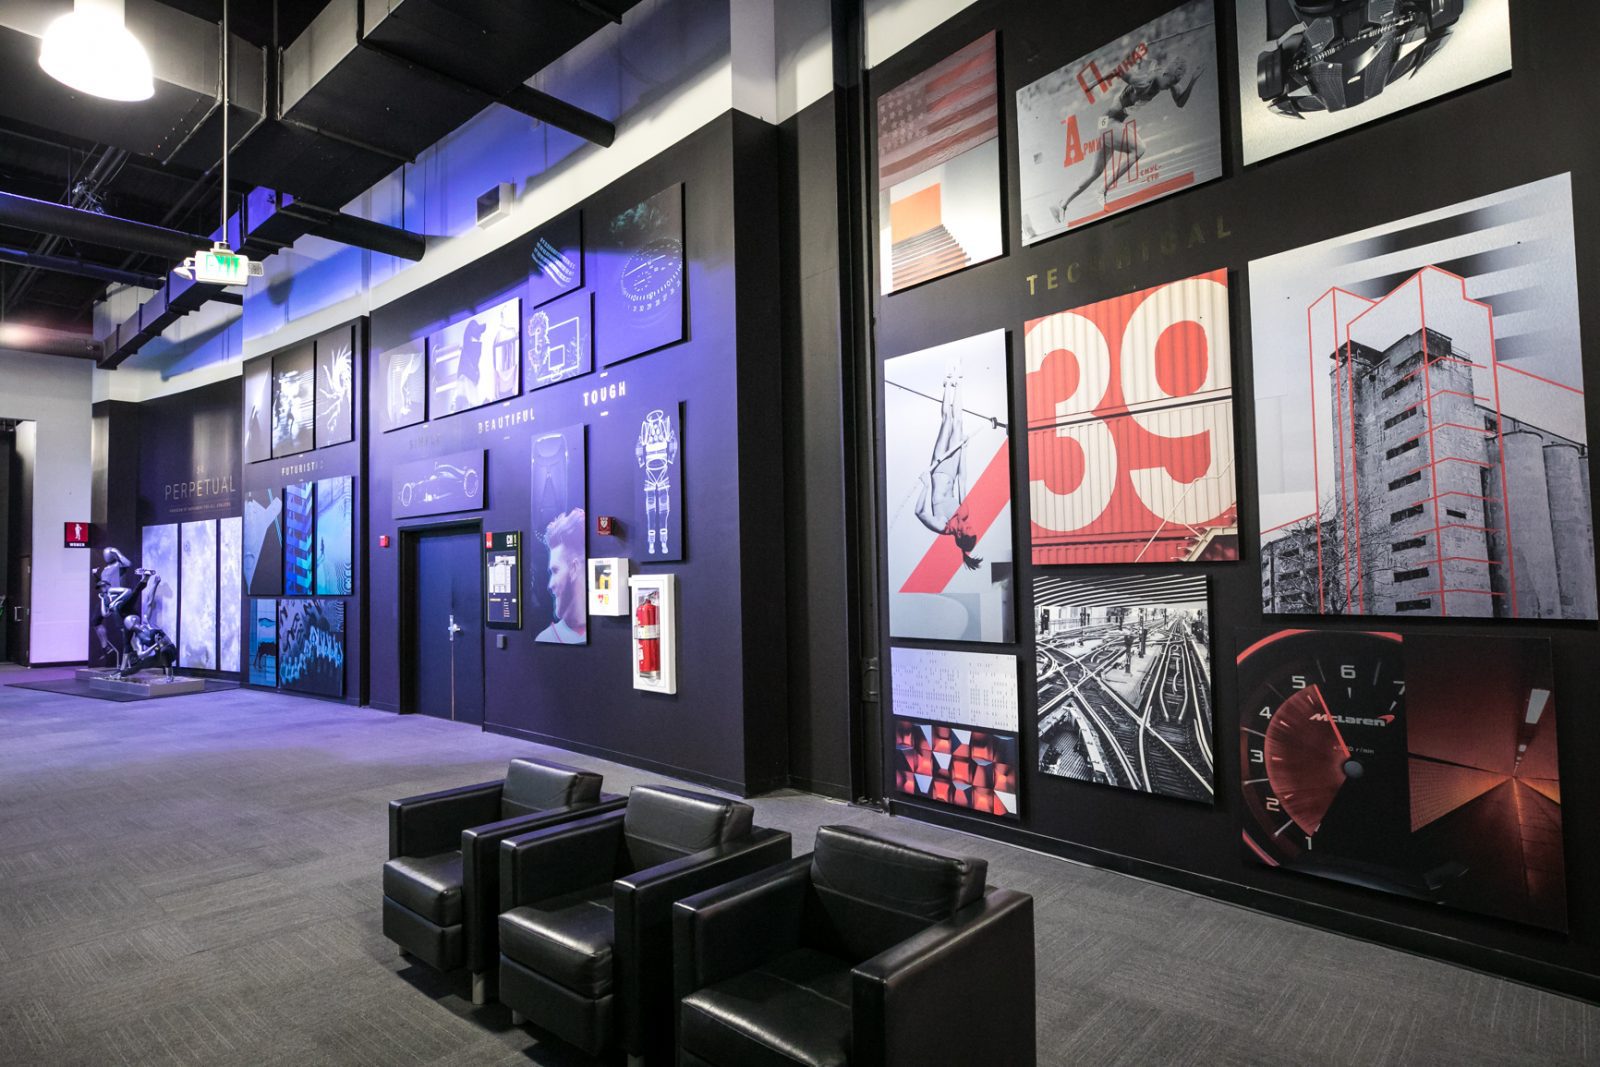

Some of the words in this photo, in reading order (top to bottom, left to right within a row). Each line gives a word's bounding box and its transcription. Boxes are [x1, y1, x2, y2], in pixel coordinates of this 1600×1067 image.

[1026, 215, 1231, 296] TECICAL
[206, 254, 240, 276] EXIT
[583, 381, 627, 407] TOUGH
[1025, 278, 1238, 533] 39
[477, 407, 536, 434] BEAUTIFUL
[164, 475, 237, 502] PERPETUAL
[1341, 665, 1356, 679] 6
[1292, 676, 1306, 689] 5
[1393, 681, 1405, 695] 7
[1259, 707, 1272, 719] 4
[1308, 713, 1387, 727] McLaren
[1250, 750, 1264, 763] 3
[1266, 797, 1280, 811] 2
[1305, 837, 1312, 850] 1
